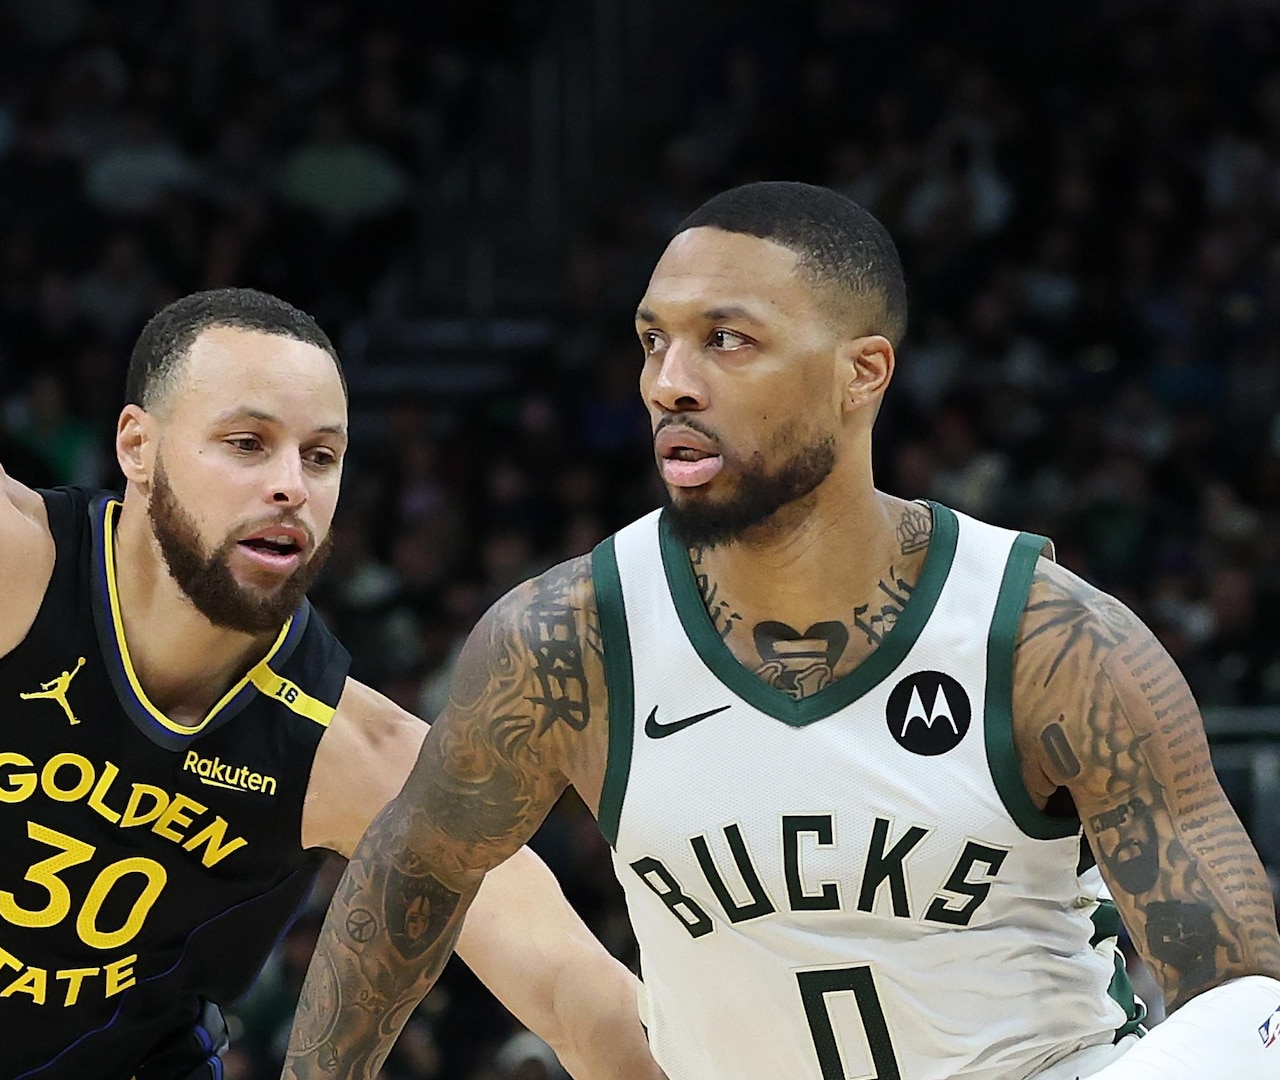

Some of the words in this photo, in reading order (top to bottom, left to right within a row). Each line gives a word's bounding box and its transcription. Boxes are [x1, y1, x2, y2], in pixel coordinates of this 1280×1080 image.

[275, 682, 299, 704] 16
[182, 750, 278, 796] Rakuten
[628, 811, 1013, 939] BUCKS
